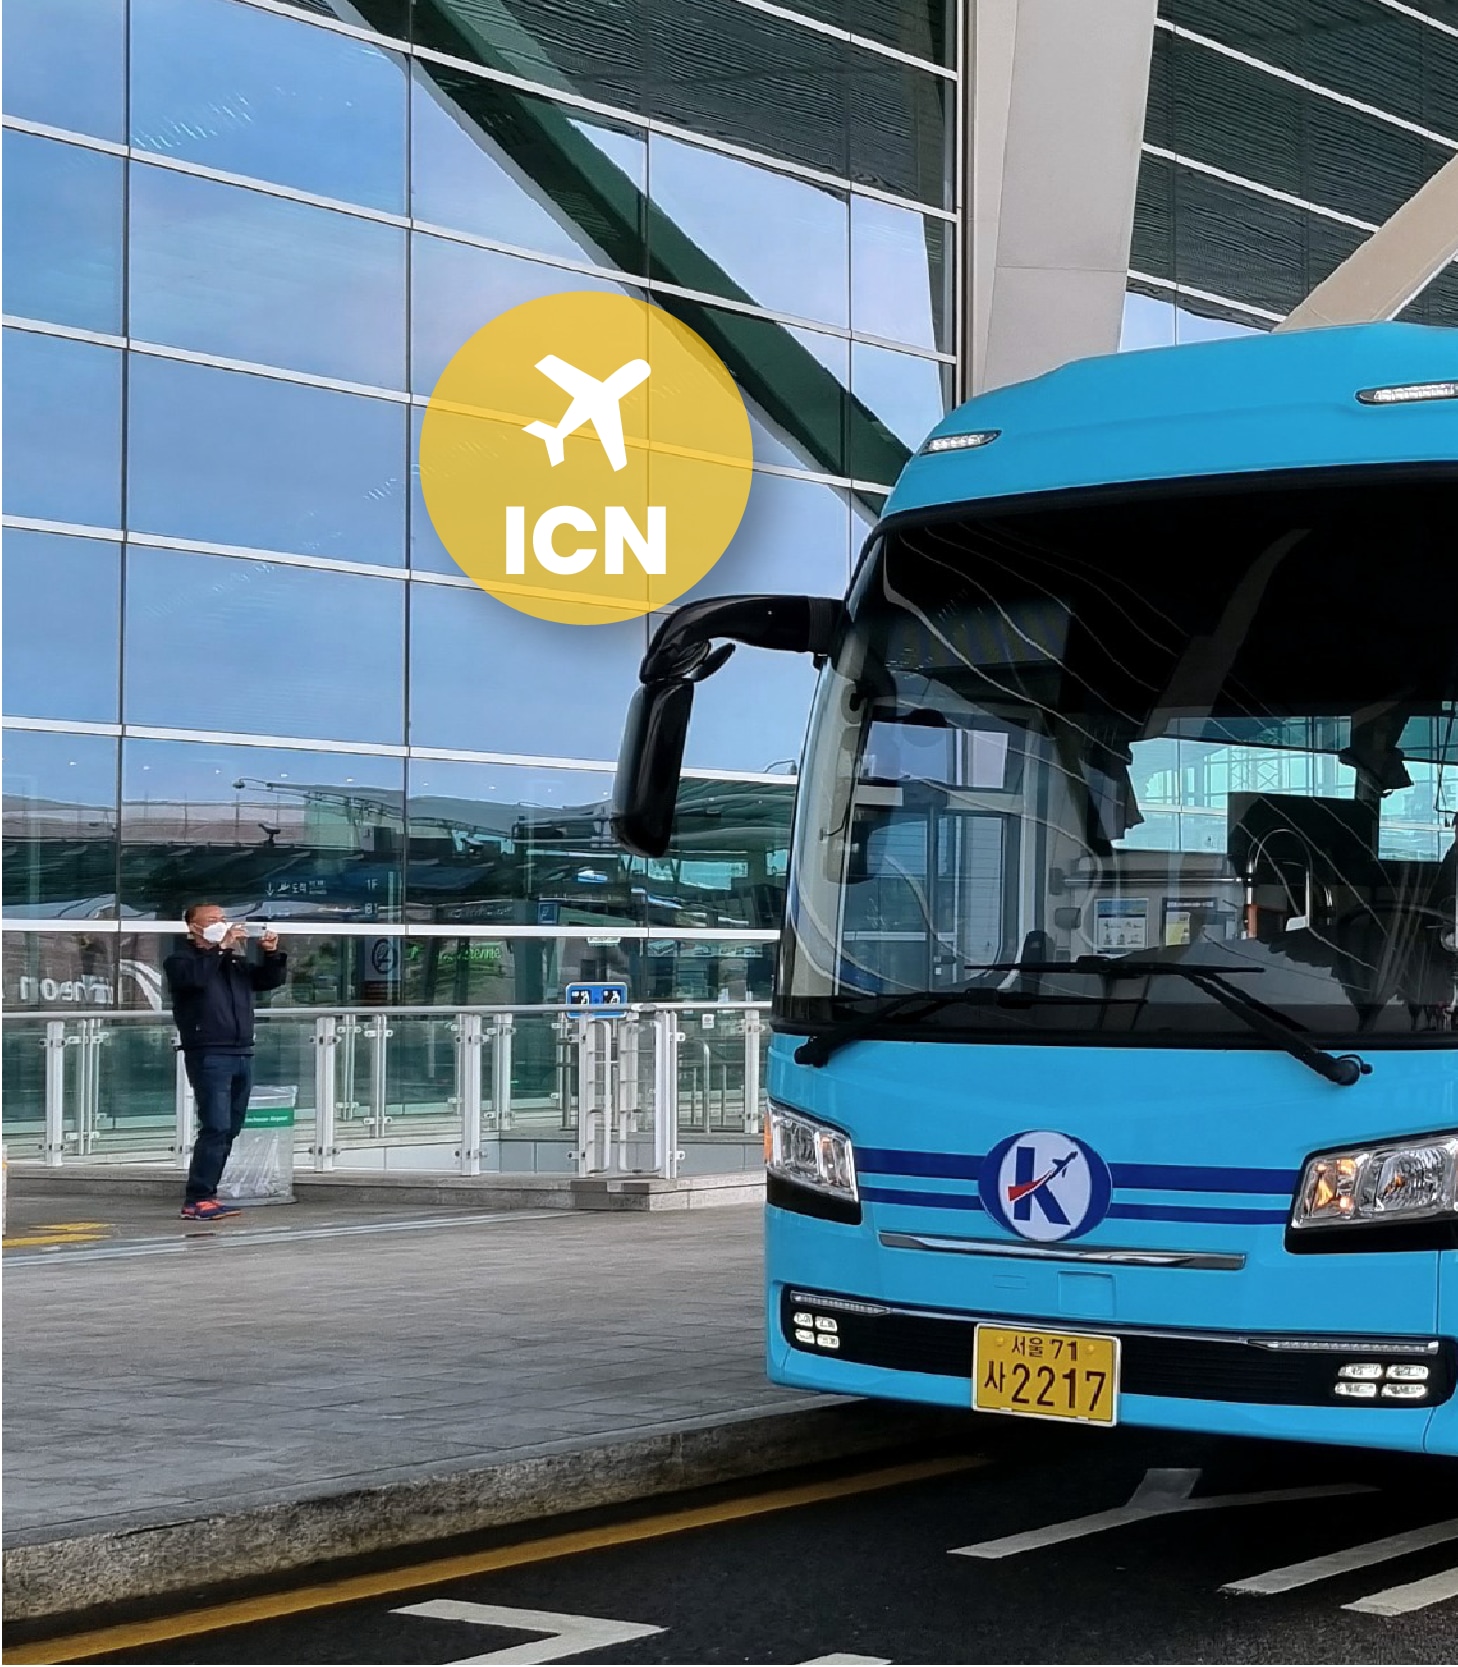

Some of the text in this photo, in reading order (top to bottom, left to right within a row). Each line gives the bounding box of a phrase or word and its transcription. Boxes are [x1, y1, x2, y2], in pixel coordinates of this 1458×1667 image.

[1008, 1146, 1078, 1226] K
[1011, 1335, 1079, 1362] 서울 71
